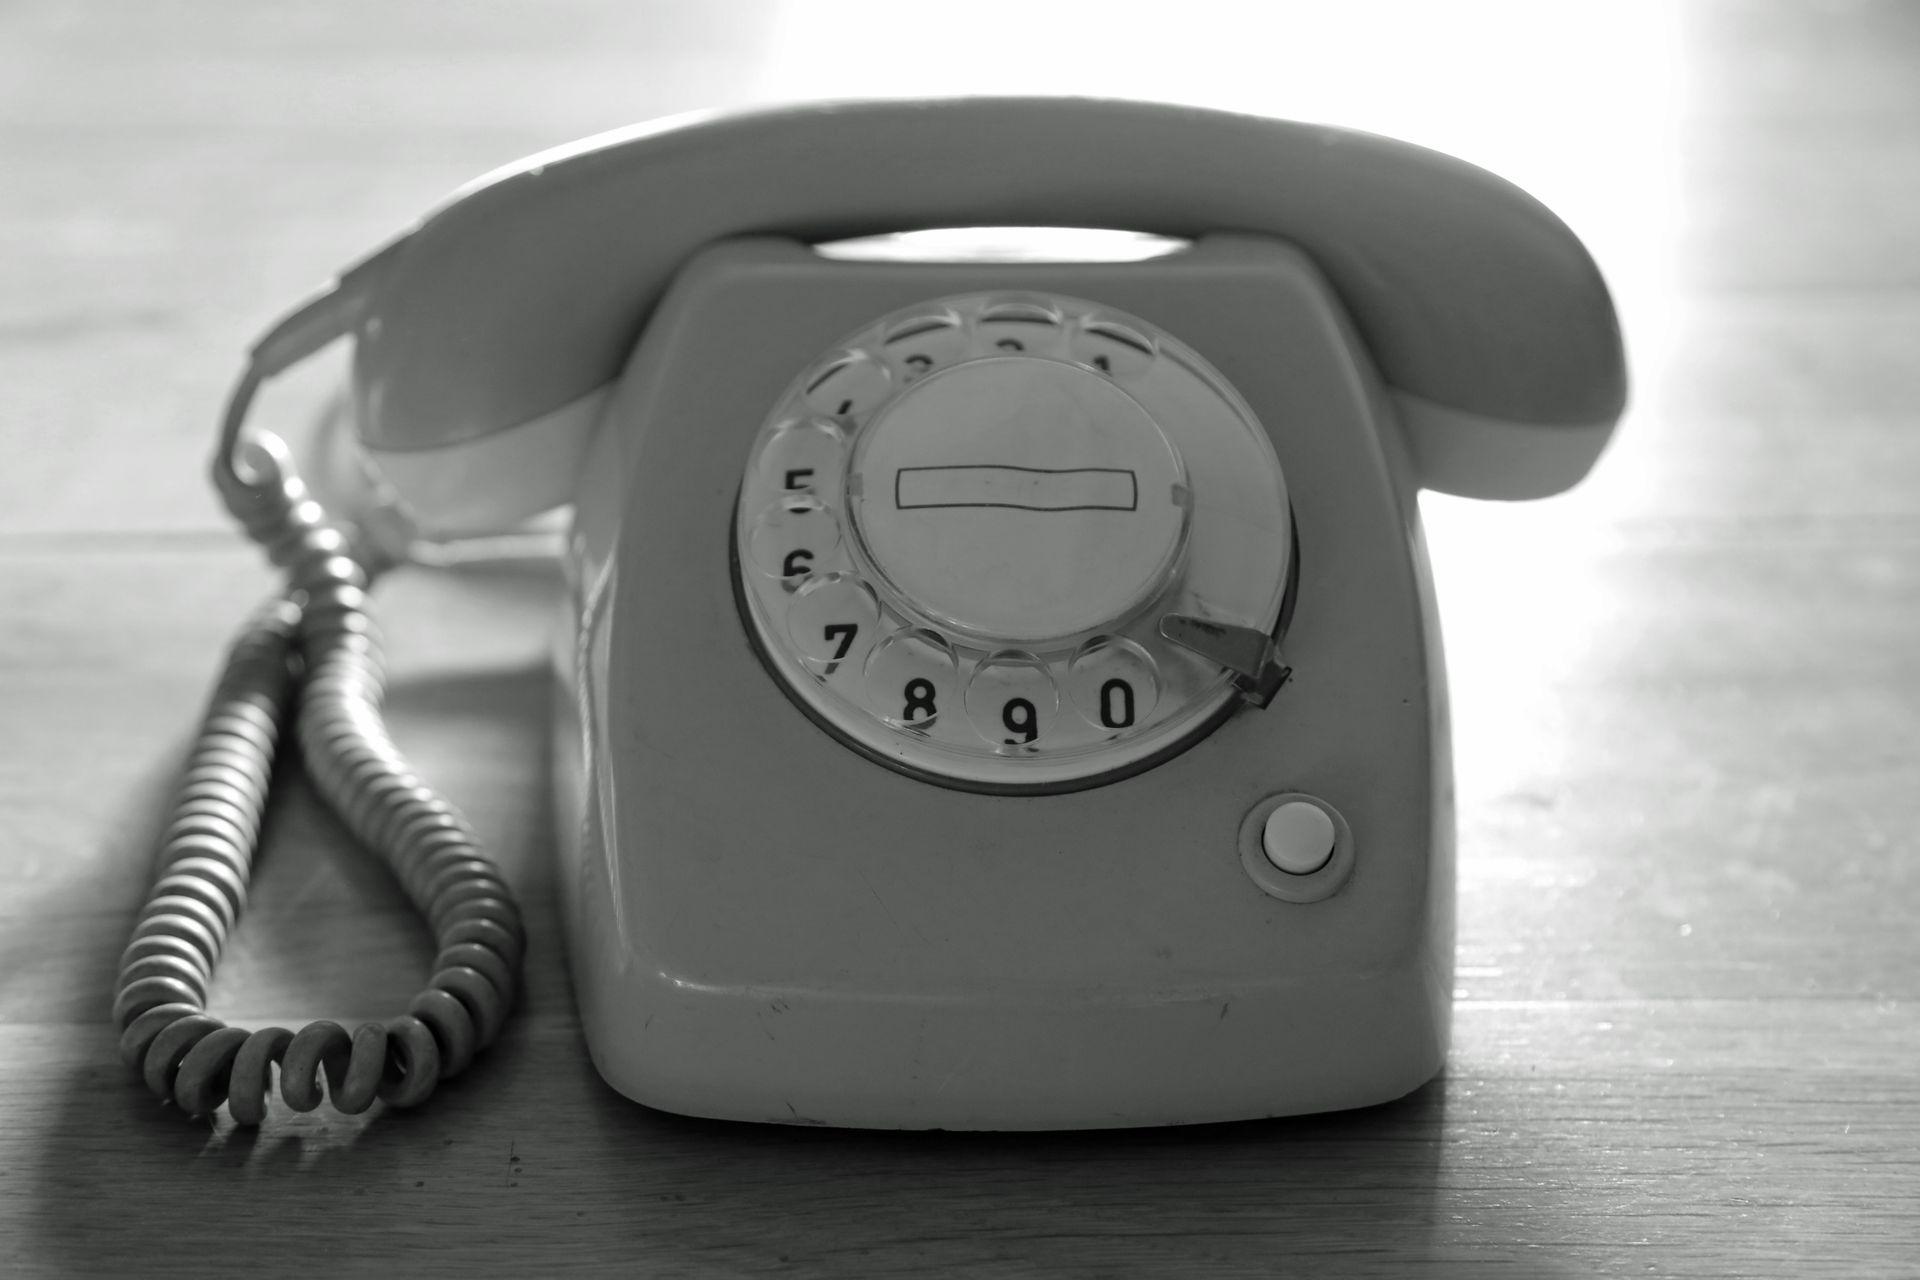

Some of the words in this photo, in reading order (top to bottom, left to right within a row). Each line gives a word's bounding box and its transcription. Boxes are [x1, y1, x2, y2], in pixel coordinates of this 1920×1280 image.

[781, 548, 815, 593] 6
[823, 623, 858, 675] 7
[903, 678, 938, 730] 8
[1002, 697, 1039, 746] 9
[1100, 678, 1135, 729] 0
